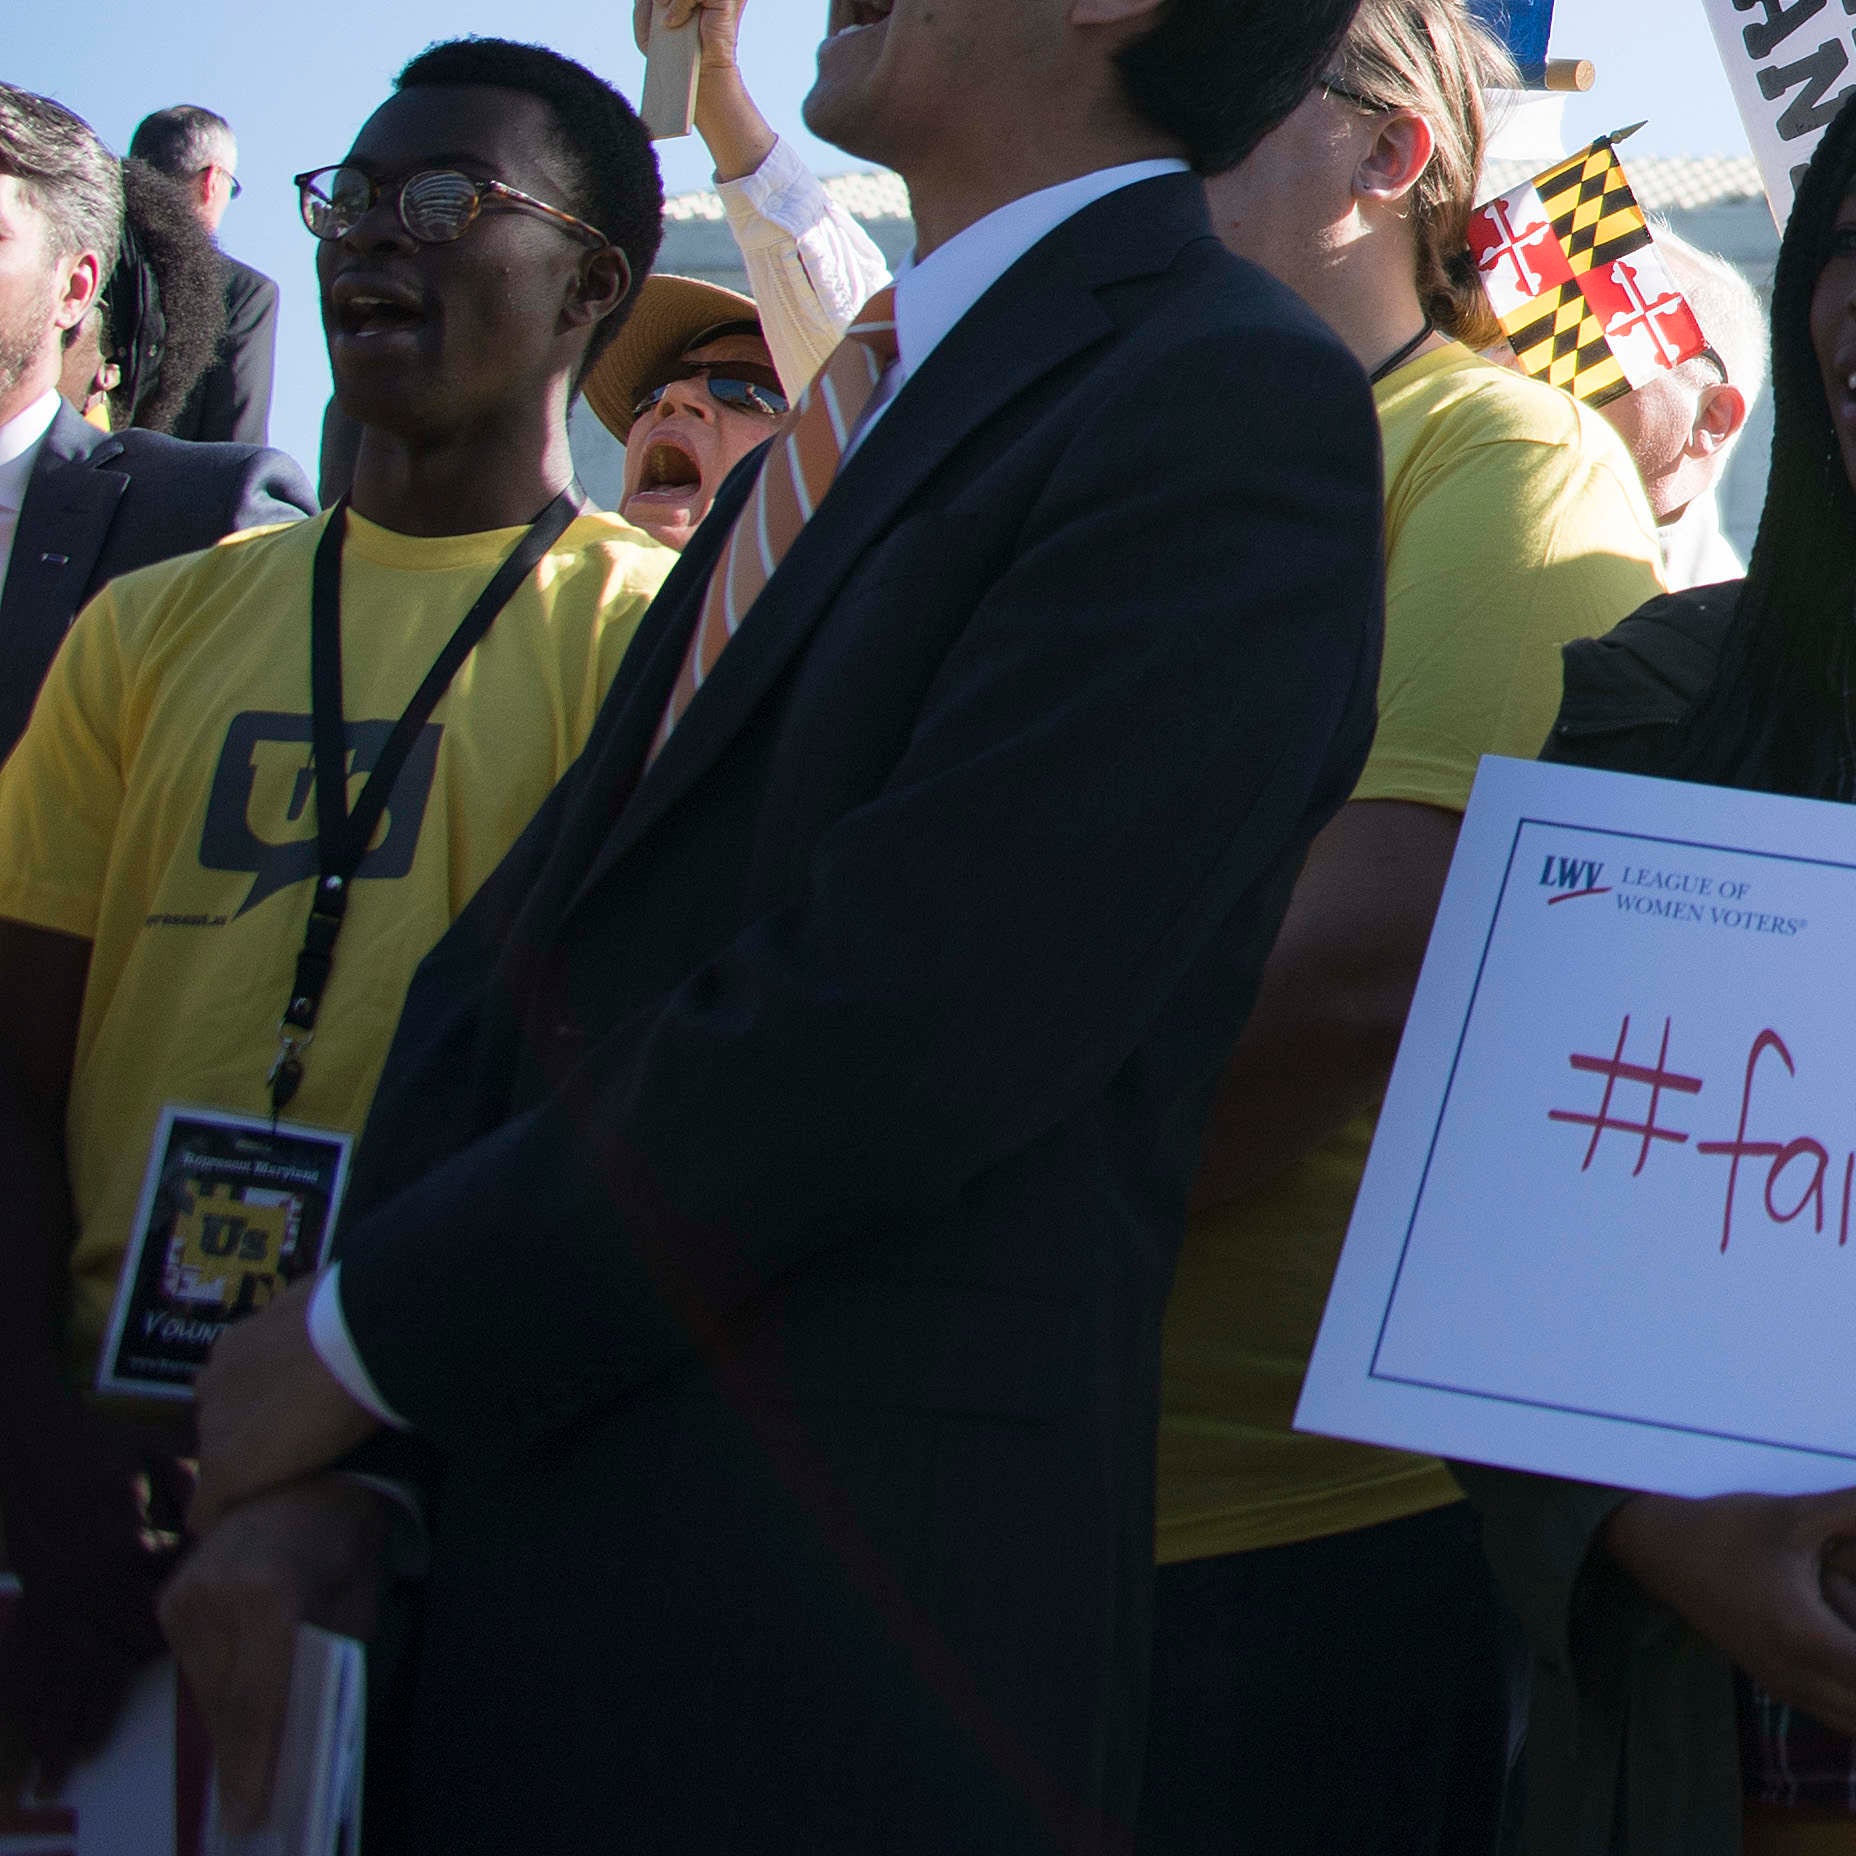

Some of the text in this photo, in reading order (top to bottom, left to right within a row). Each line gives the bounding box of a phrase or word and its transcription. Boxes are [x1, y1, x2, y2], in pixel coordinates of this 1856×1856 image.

[1540, 855, 1605, 891] LWV
[1621, 866, 1750, 901] LEAGUE OF
[1615, 893, 1706, 922] WOMEN
